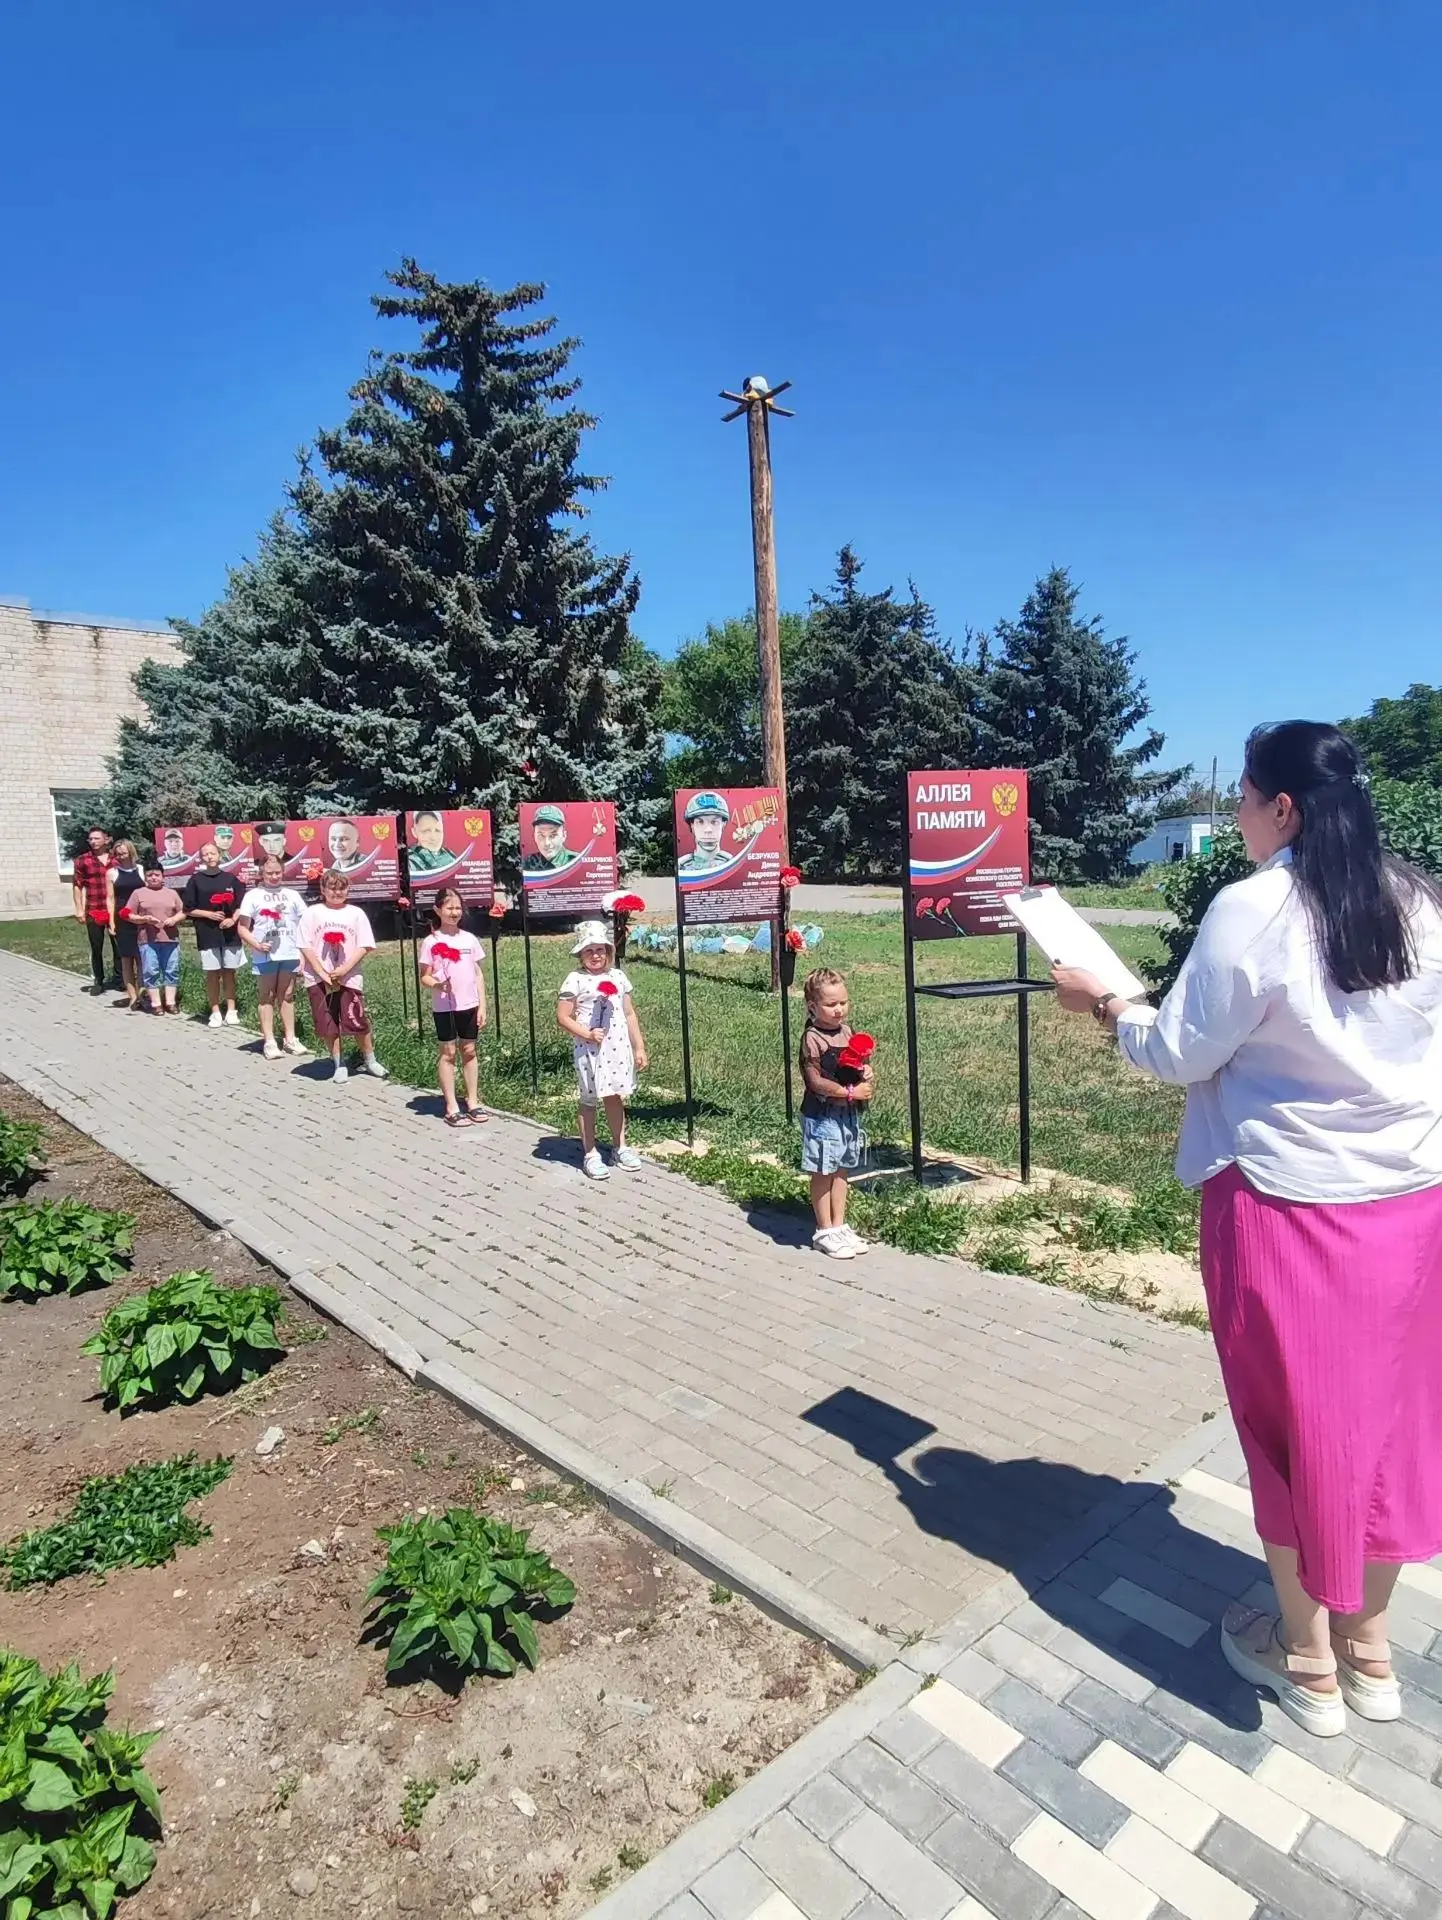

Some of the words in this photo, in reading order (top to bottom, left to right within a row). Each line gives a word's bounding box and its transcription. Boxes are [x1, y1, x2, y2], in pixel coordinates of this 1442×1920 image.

[916, 784, 971, 803] АЛЛЕЯ
[917, 810, 985, 830] ПАМЯТИ
[748, 852, 780, 860] БЕЗРУКОВ
[748, 871, 780, 879] Андреевич
